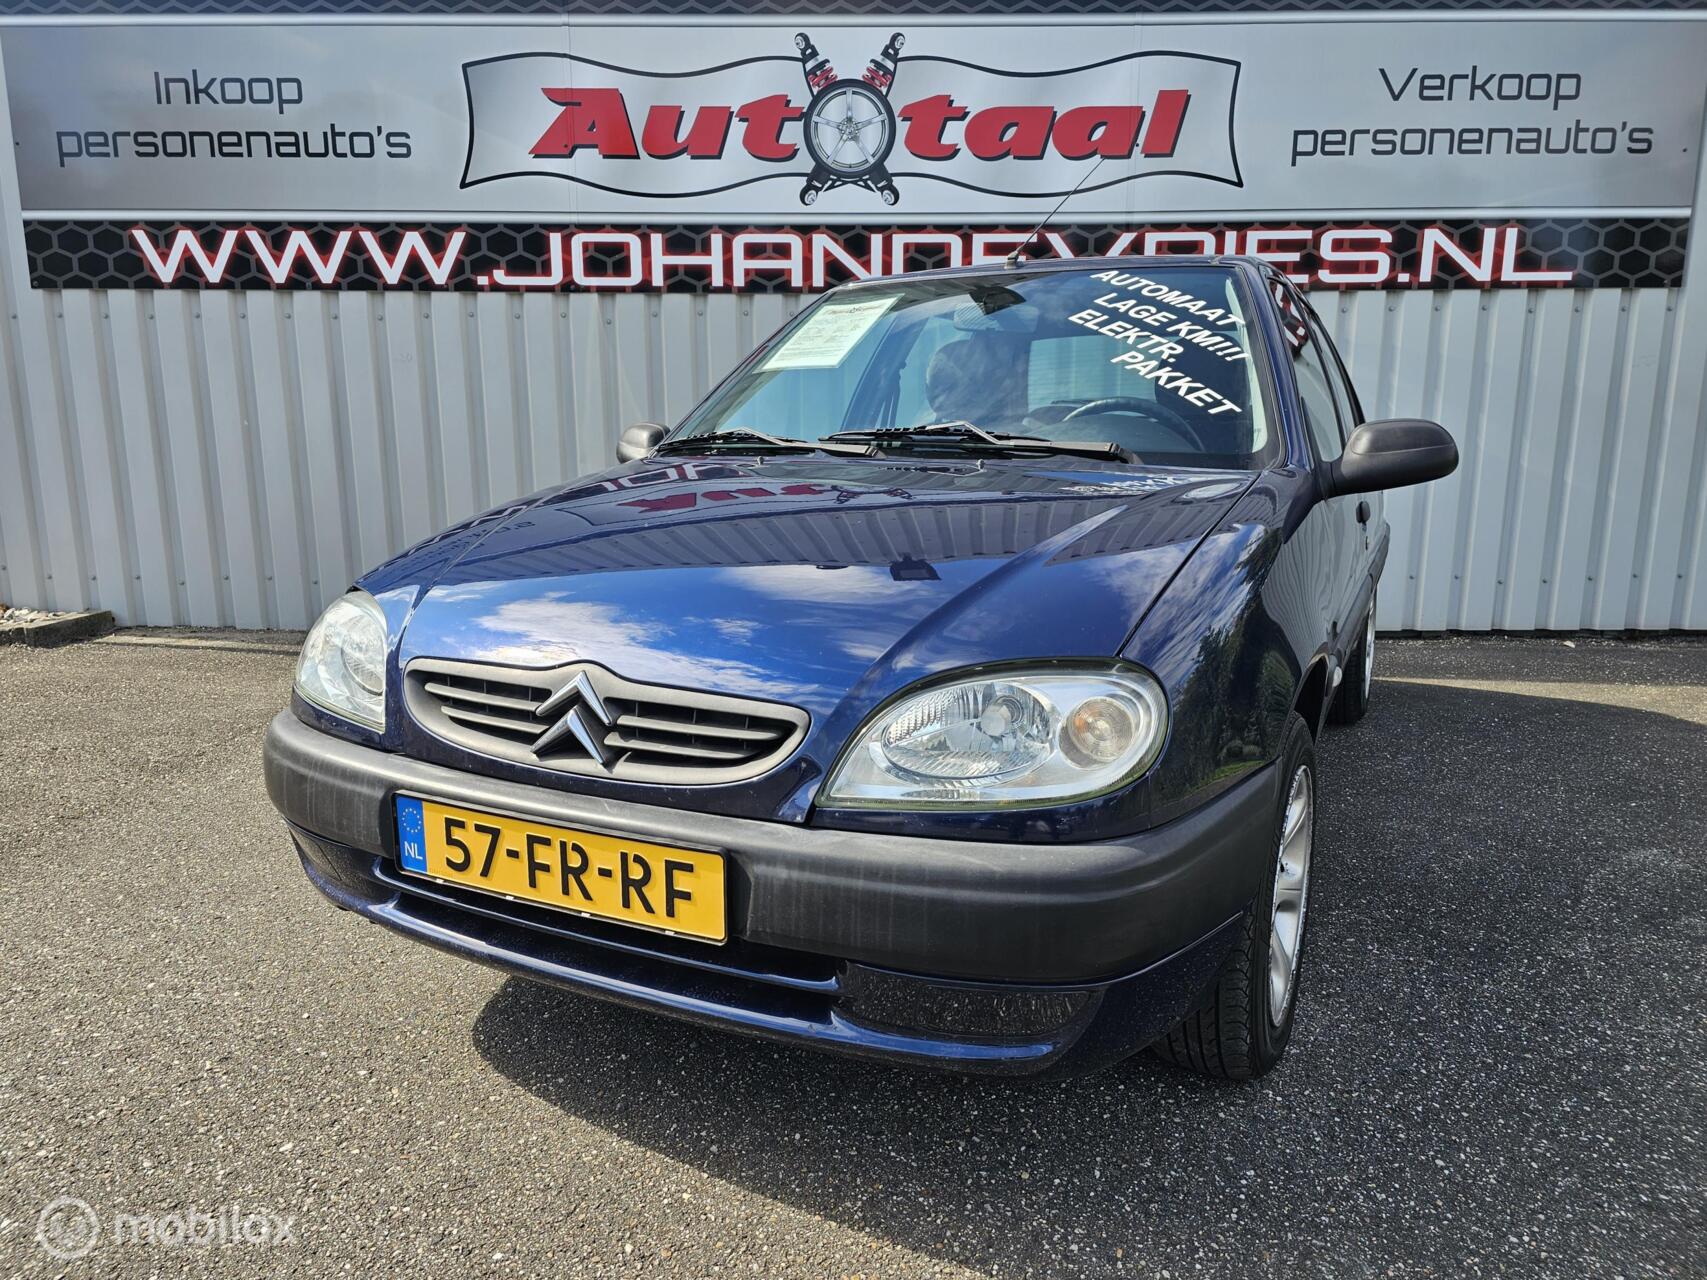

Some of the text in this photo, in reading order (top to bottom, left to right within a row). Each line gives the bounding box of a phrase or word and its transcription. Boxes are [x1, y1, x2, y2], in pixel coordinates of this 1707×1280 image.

[154, 69, 303, 114] Inkoop
[1379, 65, 1582, 111] Verkoop
[56, 123, 412, 167] personenauto's
[1291, 120, 1654, 167] personenauto's
[1090, 270, 1245, 327] AUTOMAAT
[1068, 309, 1184, 362] ELEKTR.
[1094, 292, 1249, 362] LAGE KM!!!
[1110, 351, 1242, 415] PAKKET
[404, 841, 423, 860] NL
[444, 817, 694, 917] 57-FR-RF
